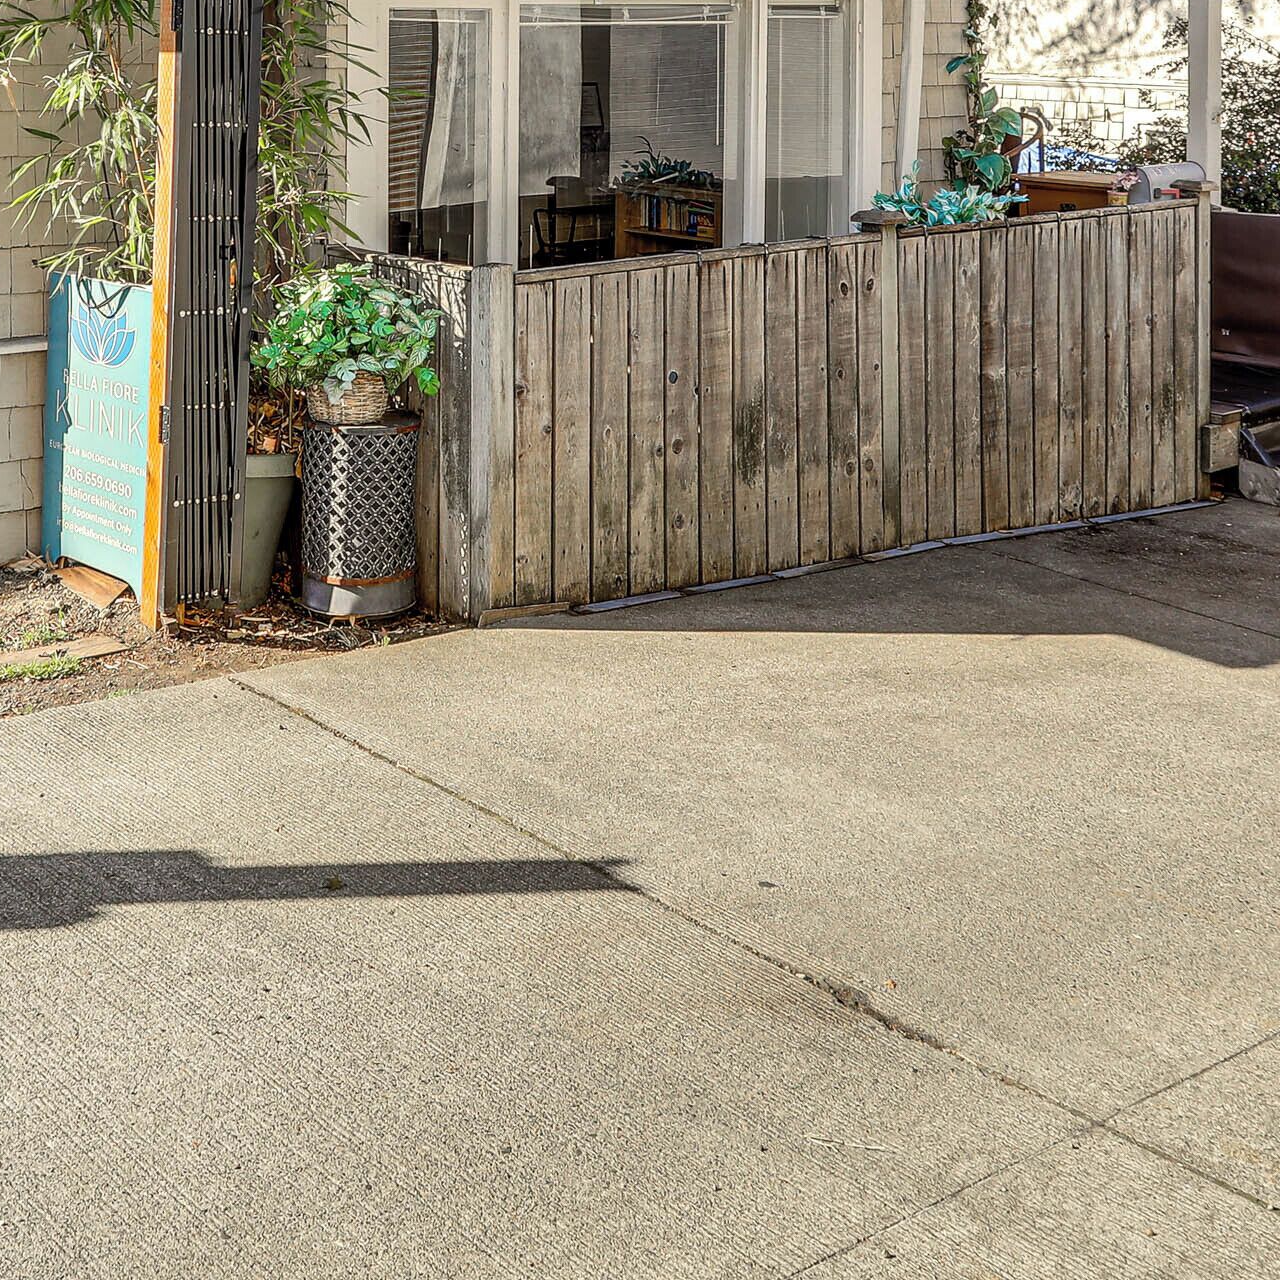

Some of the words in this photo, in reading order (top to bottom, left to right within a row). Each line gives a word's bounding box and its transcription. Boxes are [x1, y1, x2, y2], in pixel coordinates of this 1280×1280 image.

[63, 368, 98, 393] BELLA
[102, 377, 139, 404] FIORE
[56, 389, 145, 448] KLINIK
[82, 448, 119, 470] BIOLOGICAL
[120, 461, 148, 478] MEDICIN
[64, 464, 132, 498] 206.659.0690
[58, 480, 137, 520] bellafioreklinik.com
[63, 503, 71, 514] By
[72, 505, 115, 530] Appointment
[116, 521, 132, 537] Only
